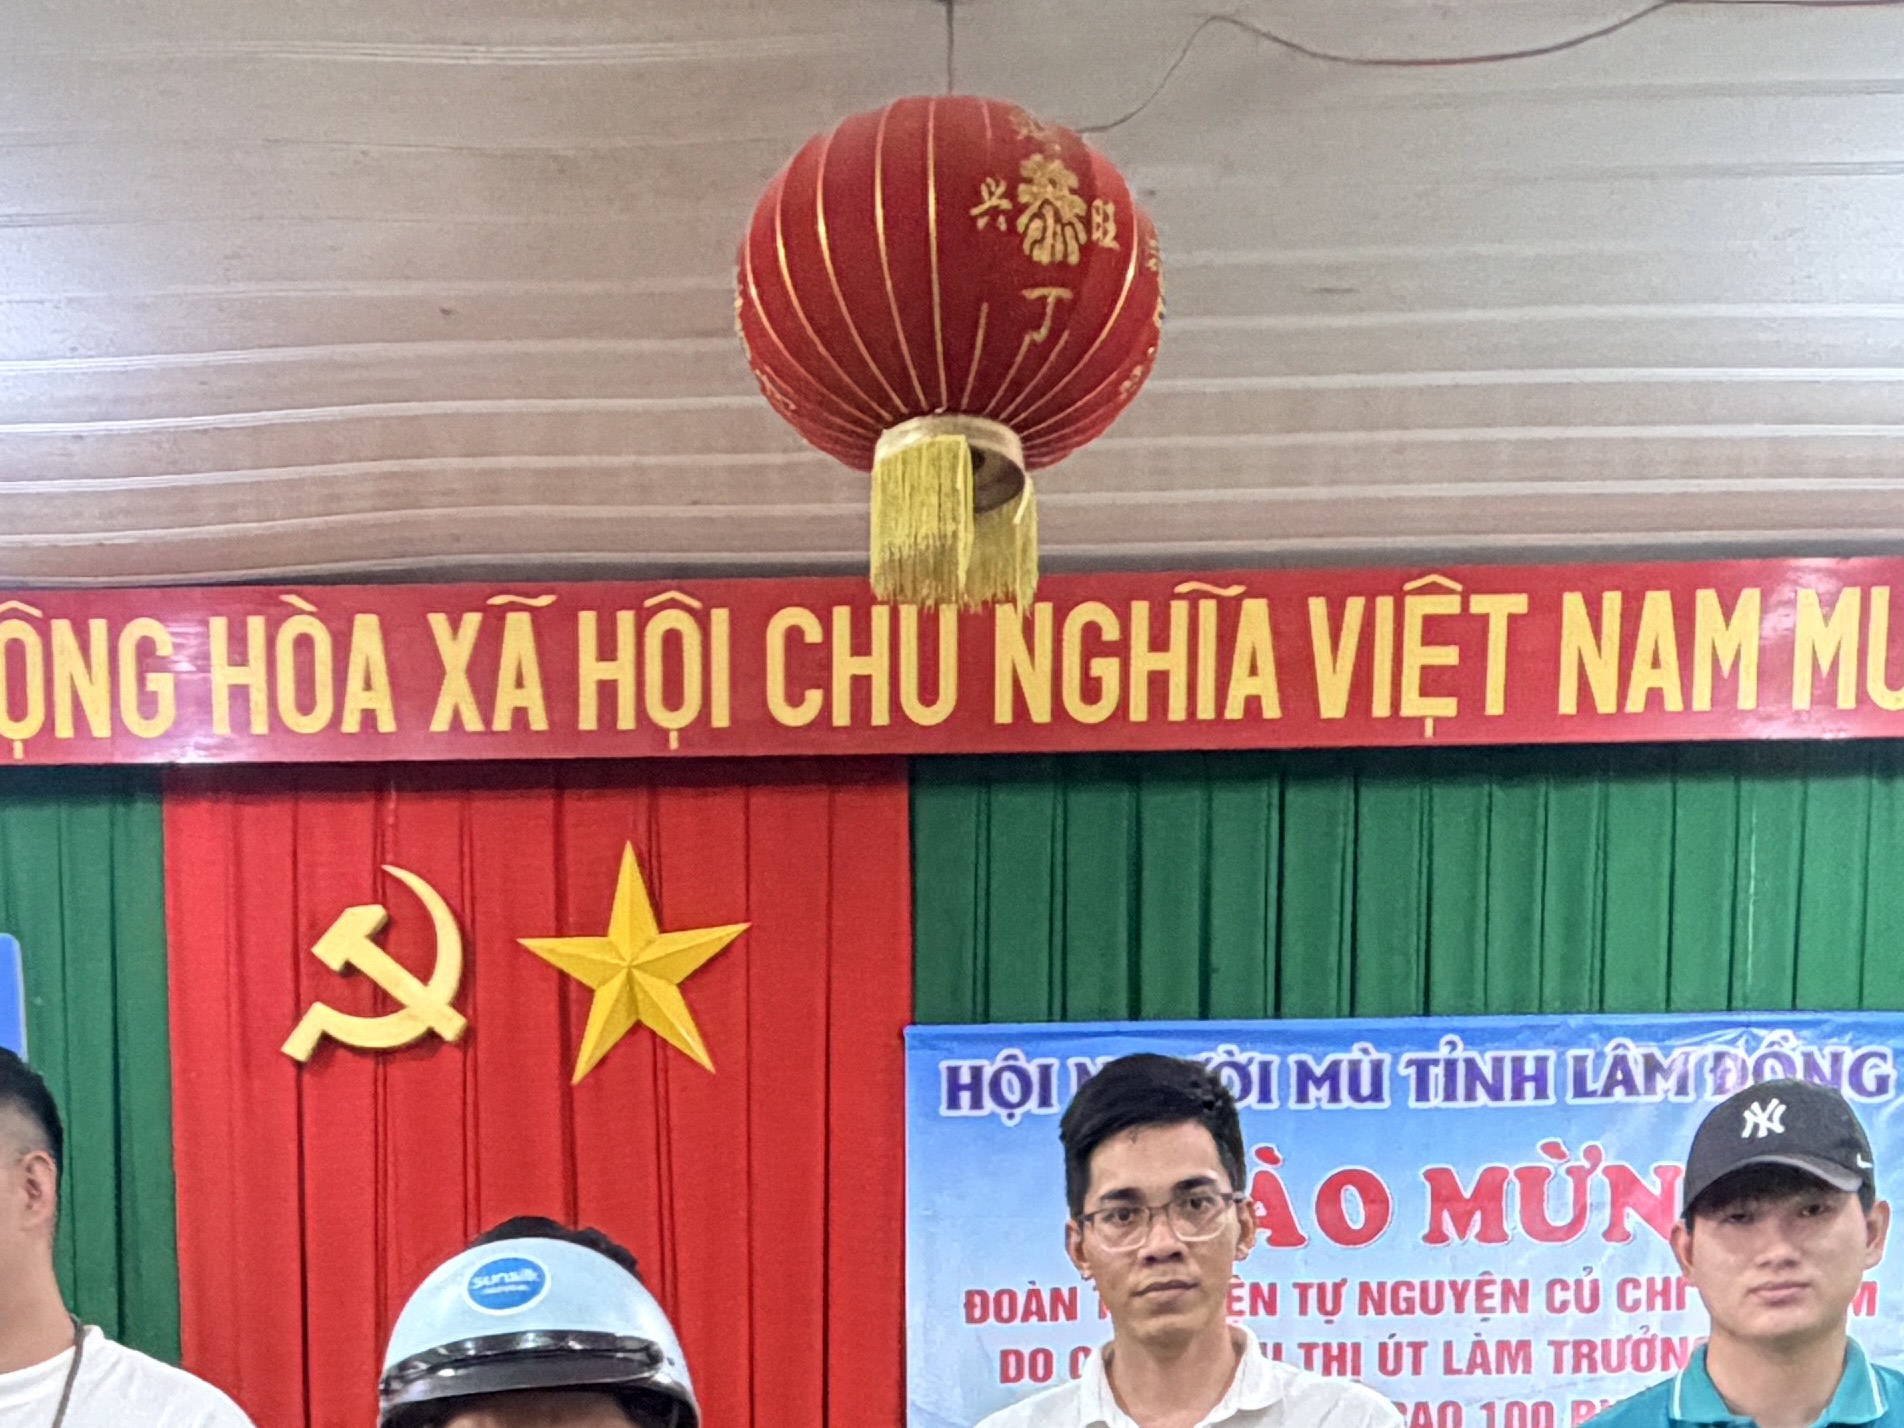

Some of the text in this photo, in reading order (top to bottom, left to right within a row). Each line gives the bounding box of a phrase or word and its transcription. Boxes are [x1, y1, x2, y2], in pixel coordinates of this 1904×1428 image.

[211, 594, 397, 735] HÒA
[427, 594, 556, 734] XÃ
[578, 591, 732, 749] HỘI
[995, 581, 1282, 724] NGHĨA
[1309, 573, 1527, 737] VIỆT
[1558, 585, 1759, 716] NAM
[945, 1053, 1054, 1120] HỘI
[1296, 1046, 1387, 1106] MÙ
[1405, 1038, 1550, 1103] TỈNH
[1571, 1042, 1689, 1099] LÂM
[1248, 1140, 1686, 1248] ÀO MỪN
[964, 1281, 1077, 1324] ĐOÀN
[1293, 1278, 1348, 1325] TỰ
[1358, 1270, 1529, 1323] NGUYỆN
[1546, 1266, 1602, 1314] CỦ
[999, 1349, 1053, 1383] DO
[1378, 1333, 1428, 1376] ÚT
[1443, 1333, 1532, 1376] LÀM
[1548, 1325, 1696, 1376] TRƯỞN
